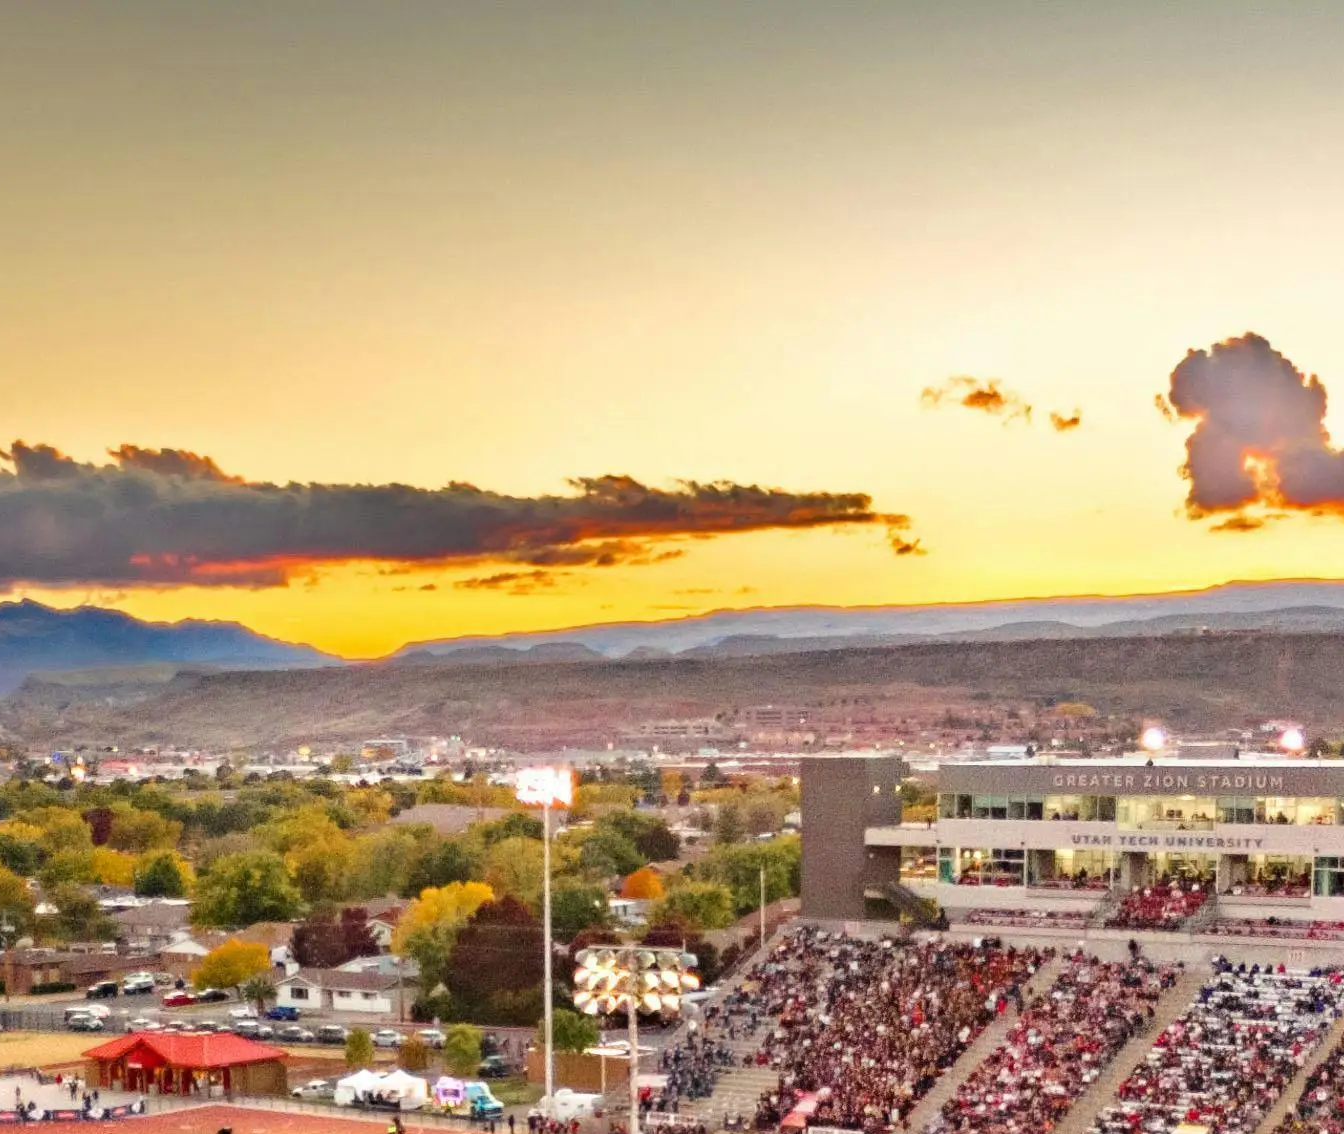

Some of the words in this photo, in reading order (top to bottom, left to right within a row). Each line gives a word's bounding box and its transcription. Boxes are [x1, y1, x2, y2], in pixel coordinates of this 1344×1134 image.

[1053, 774, 1134, 788] GREATER
[1143, 775, 1189, 788] ZION
[1197, 775, 1284, 789] STADIUM
[1072, 834, 1112, 845] UTAH
[1165, 836, 1265, 849] UNIVERSITY
